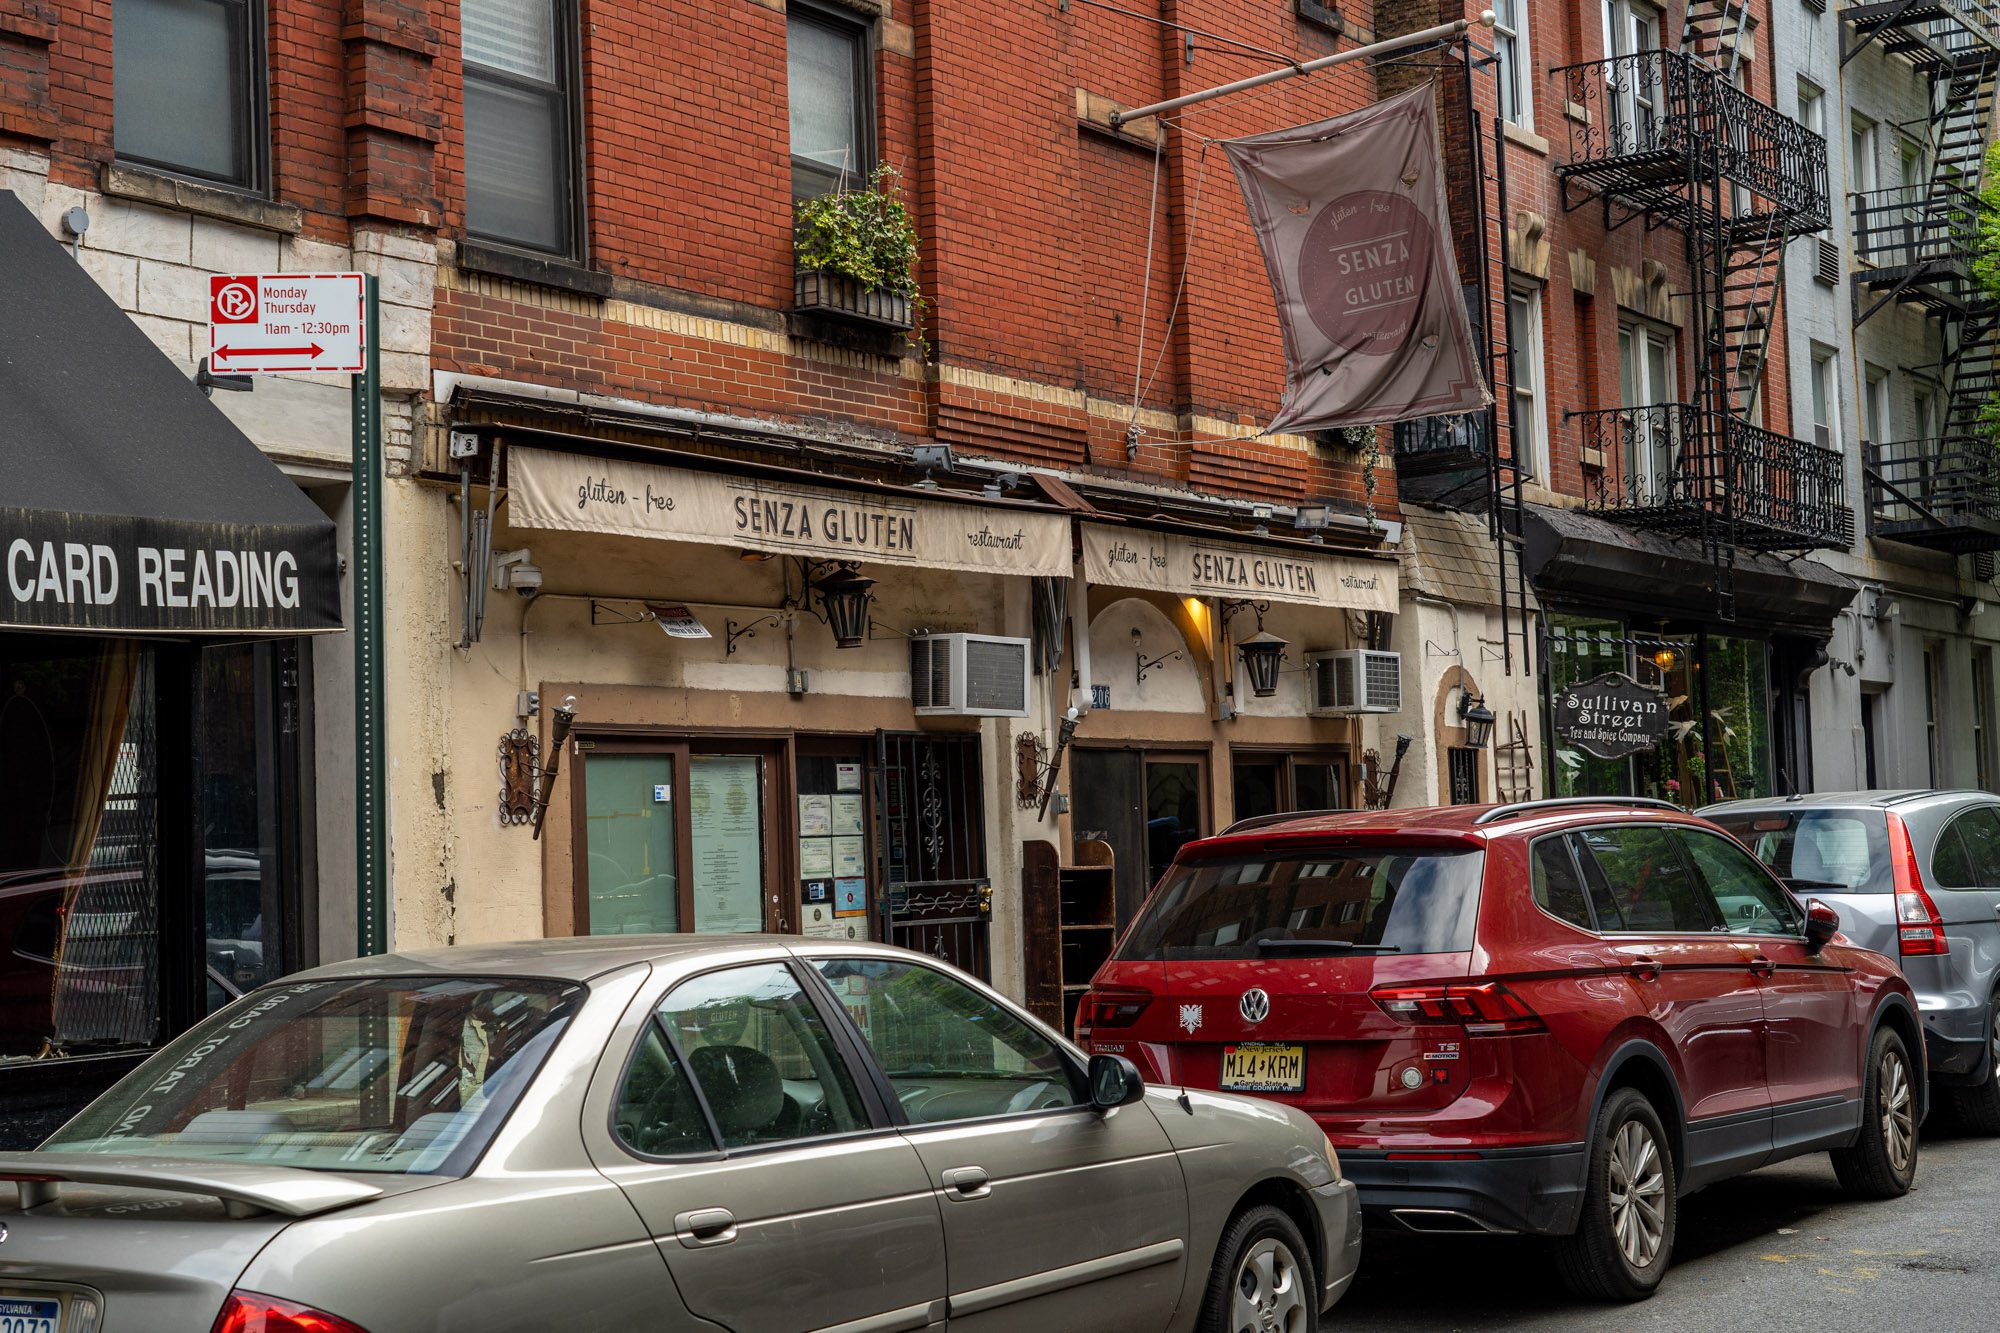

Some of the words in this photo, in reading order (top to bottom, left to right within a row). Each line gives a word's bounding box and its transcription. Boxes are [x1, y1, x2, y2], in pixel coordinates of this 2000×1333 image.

[1330, 205, 1357, 231] gluten
[1369, 198, 1391, 214] free
[1336, 239, 1410, 275] SENZA
[263, 287, 308, 300] Monday
[1344, 274, 1415, 306] GLUTEN
[264, 301, 316, 315] Thursday
[264, 323, 290, 335] 11am
[302, 322, 350, 336] 12:30pm
[578, 475, 627, 509] gluten
[645, 484, 676, 514] free
[733, 495, 812, 541] SENZA
[822, 508, 914, 551] GLUTEN
[967, 525, 1026, 551] restaurant
[1108, 540, 1138, 567] gluten
[1149, 546, 1168, 570] free
[7, 537, 119, 605] CARD
[137, 546, 301, 609] READING
[1192, 551, 1249, 585] SENZA
[1254, 559, 1317, 594] GLUTEN
[1340, 571, 1379, 590] restaurant
[1092, 689, 1110, 706] 206
[1566, 693, 1658, 714] Sullivan
[1578, 709, 1643, 728] Street
[1569, 725, 1582, 739] Tea
[1583, 727, 1597, 740] and
[1597, 727, 1617, 743] Spice
[1618, 728, 1650, 745] Company
[1242, 1045, 1260, 1054] New
[1260, 1046, 1285, 1055] Jersey
[1225, 1054, 1257, 1078] M14
[1267, 1055, 1299, 1079] KRM
[1239, 1079, 1264, 1087] Garden
[1265, 1080, 1283, 1088] State
